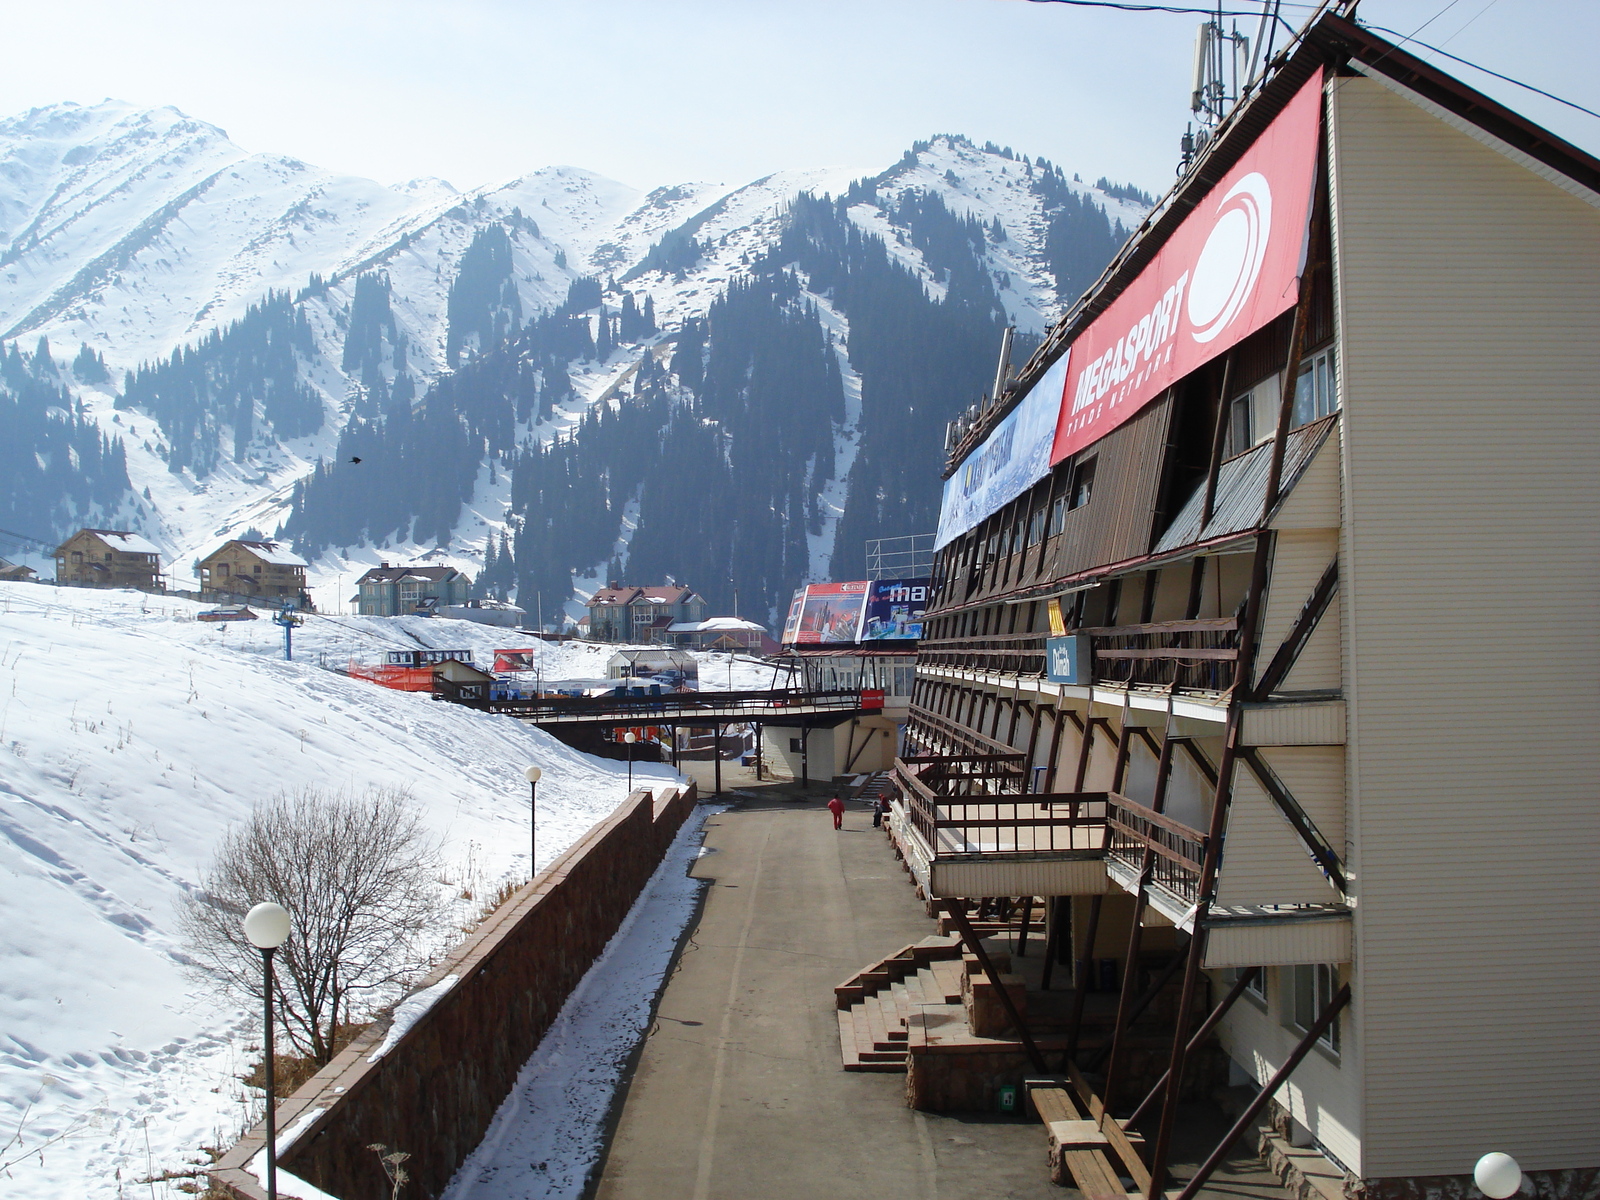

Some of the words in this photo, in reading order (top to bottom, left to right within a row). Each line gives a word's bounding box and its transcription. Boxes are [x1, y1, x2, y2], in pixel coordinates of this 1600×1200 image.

[1067, 403, 1103, 437] TRADE
[1109, 343, 1174, 409] NETWORK
[1071, 270, 1189, 417] MEGASPORT
